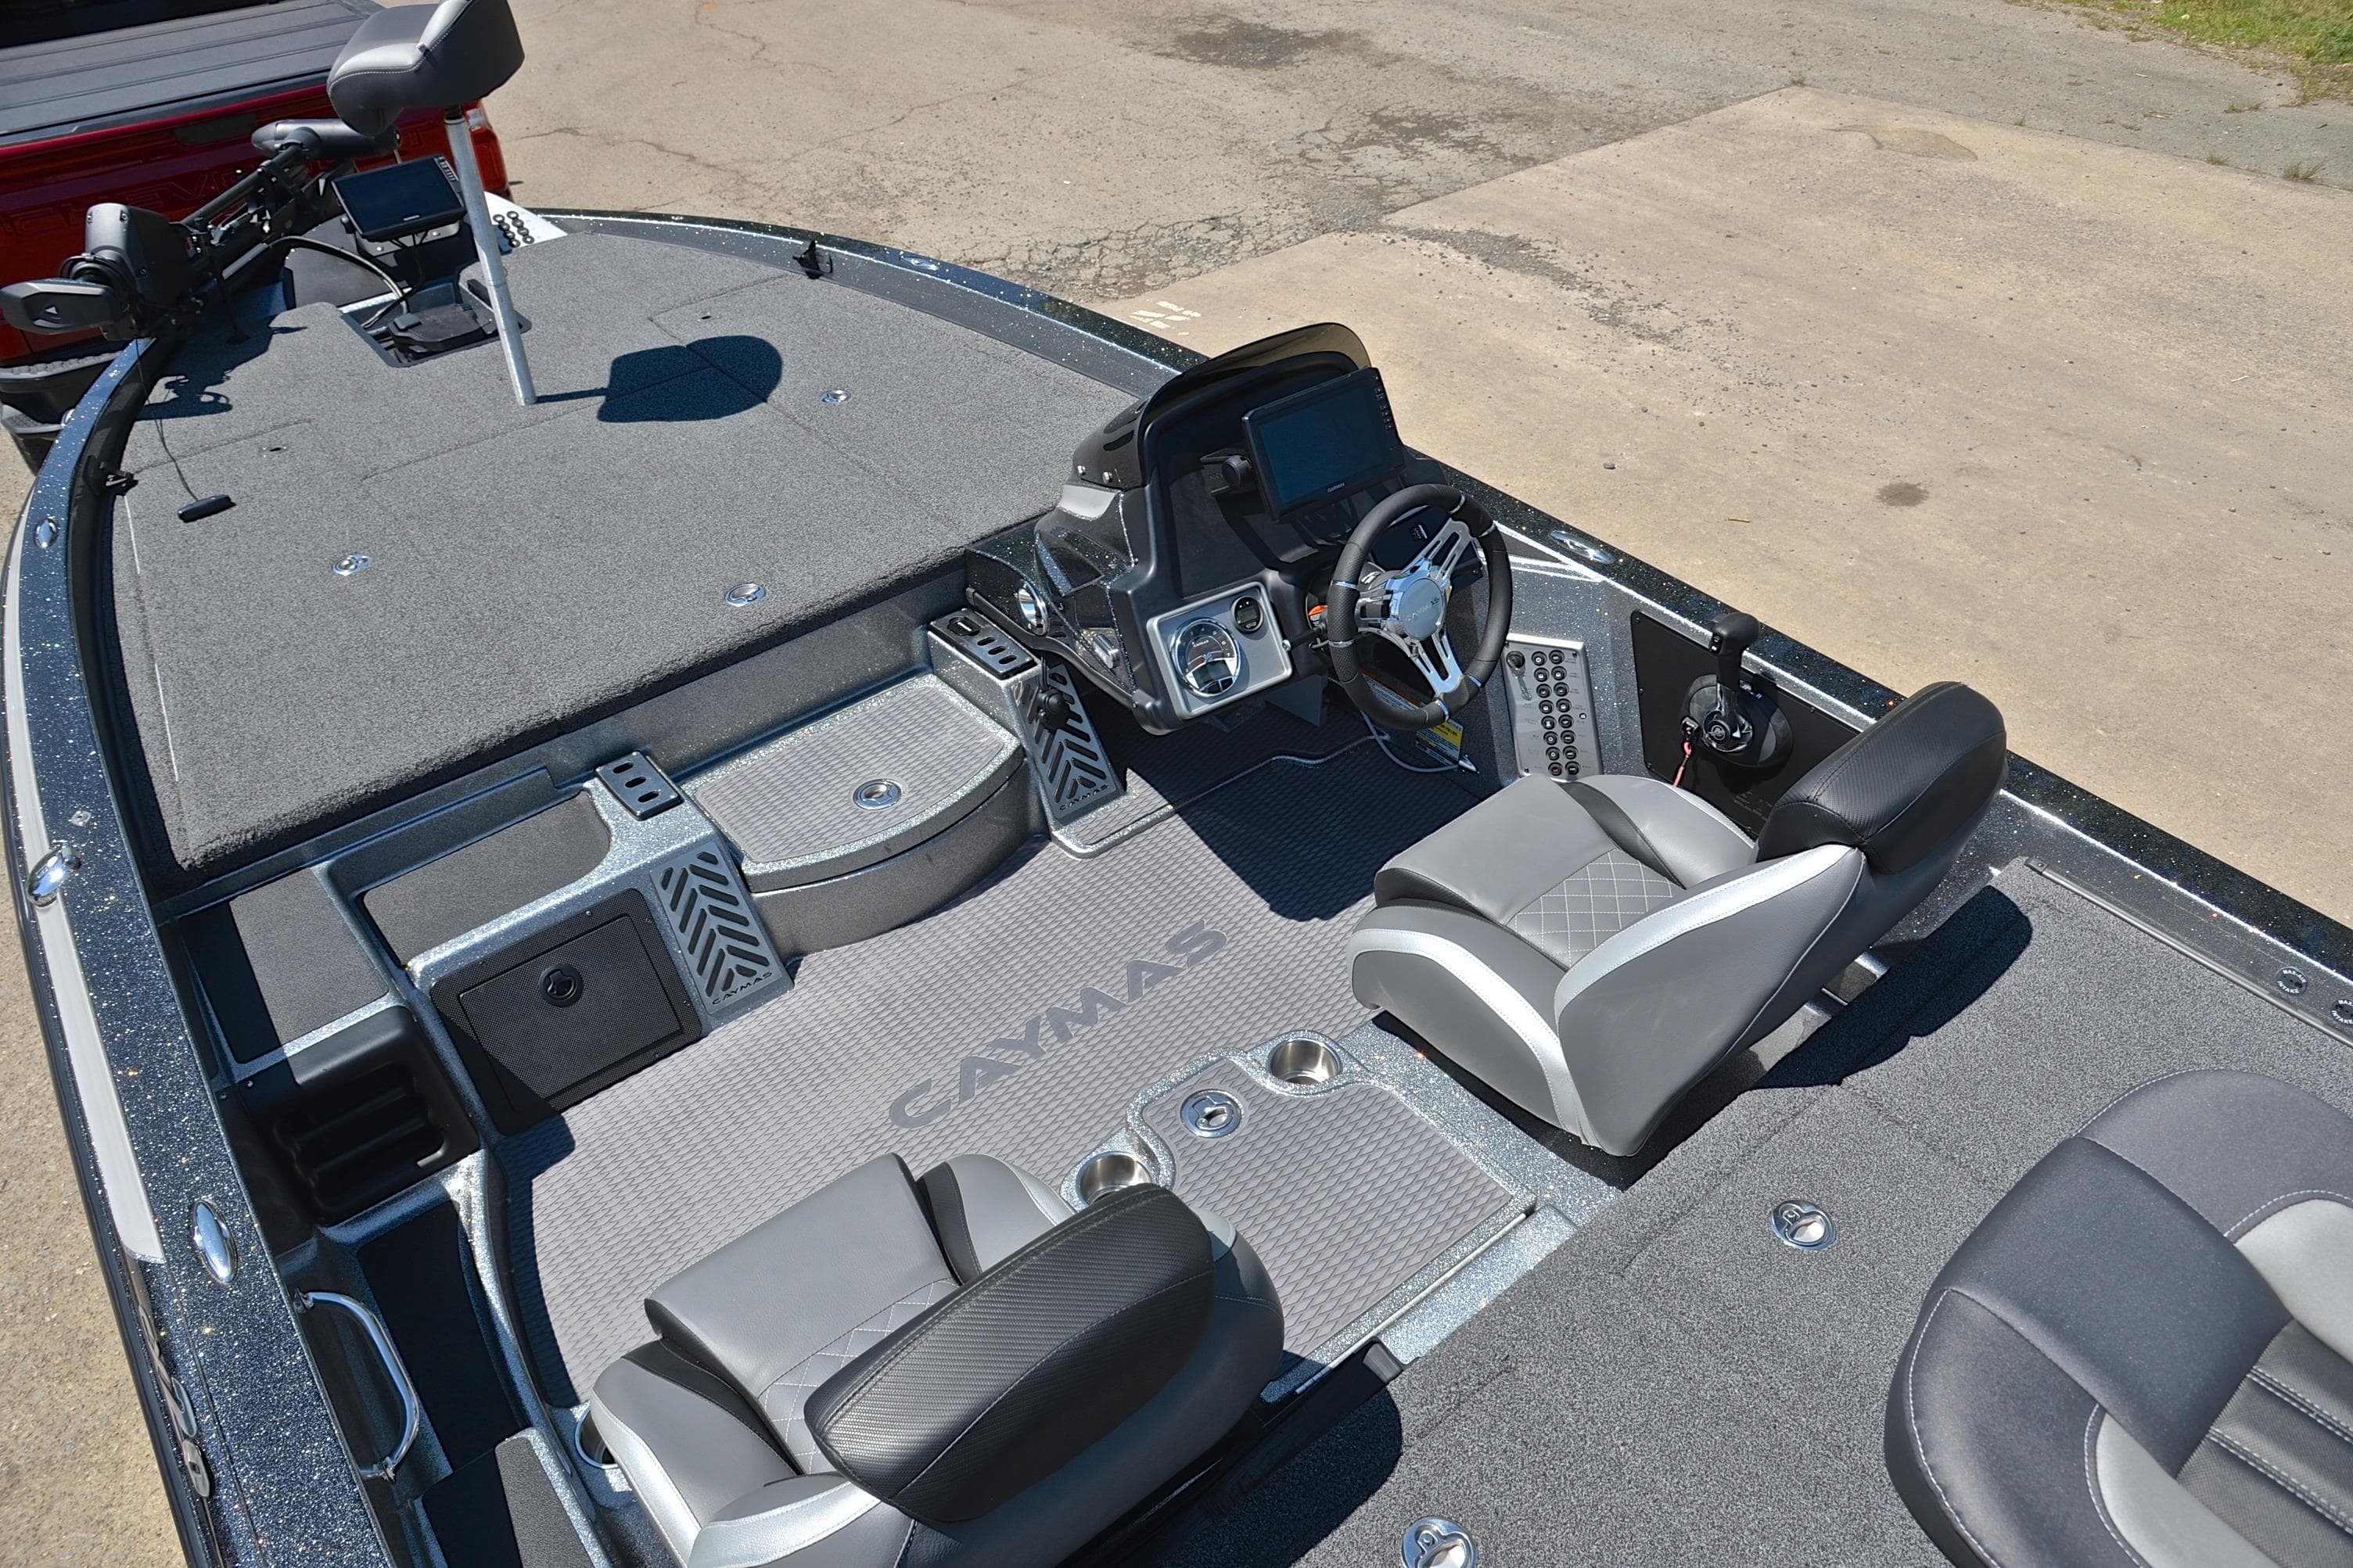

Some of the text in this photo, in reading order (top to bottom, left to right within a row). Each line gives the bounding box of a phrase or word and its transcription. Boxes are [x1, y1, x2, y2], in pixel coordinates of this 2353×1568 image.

[1059, 784, 1108, 811] CAYMAS
[712, 971, 773, 1005] CAYMAS
[2277, 981, 2300, 994] INTAKE
[889, 919, 1228, 1129] CAYMAS
